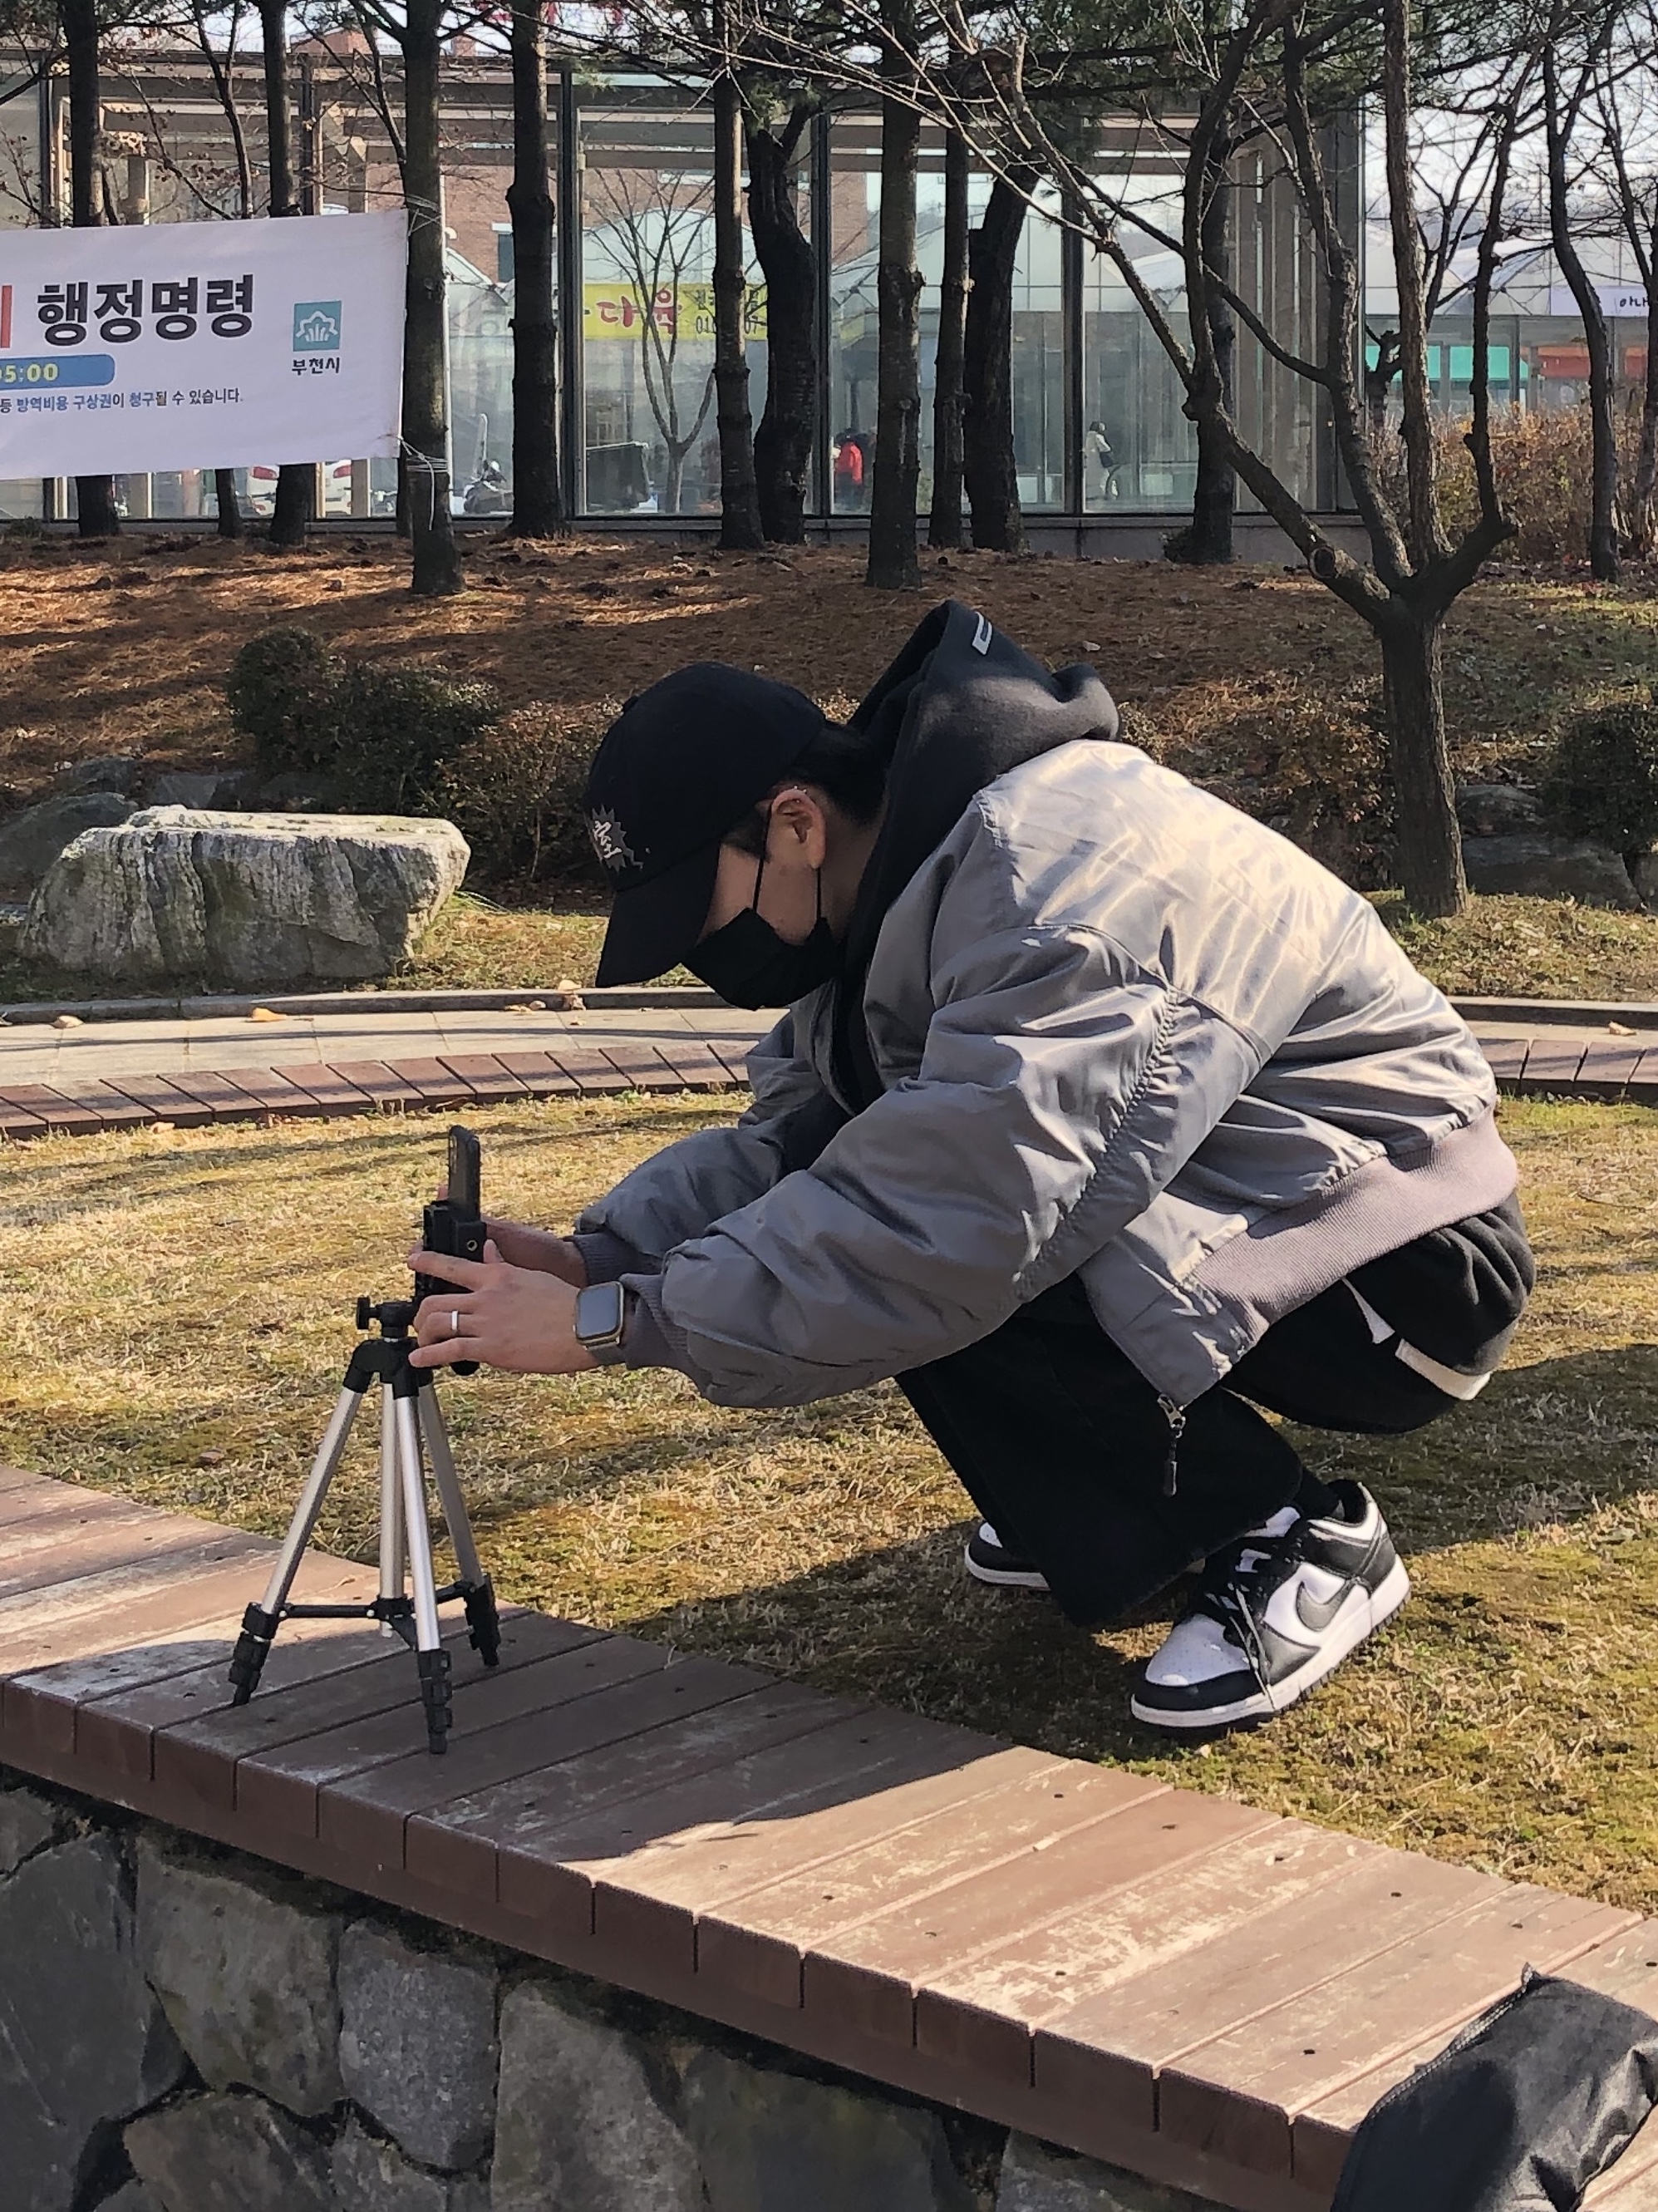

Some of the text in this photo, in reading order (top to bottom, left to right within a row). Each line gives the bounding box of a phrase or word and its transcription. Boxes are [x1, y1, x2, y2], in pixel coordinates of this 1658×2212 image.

[37, 274, 253, 347] 행정명령
[0, 363, 58, 383] 5:00
[292, 357, 340, 376] 부천시
[17, 396, 68, 412] 방역비용
[73, 392, 124, 410] 구상권이
[129, 391, 167, 407] 청구될
[172, 391, 184, 406] 수
[189, 387, 244, 405] 있습니다.
